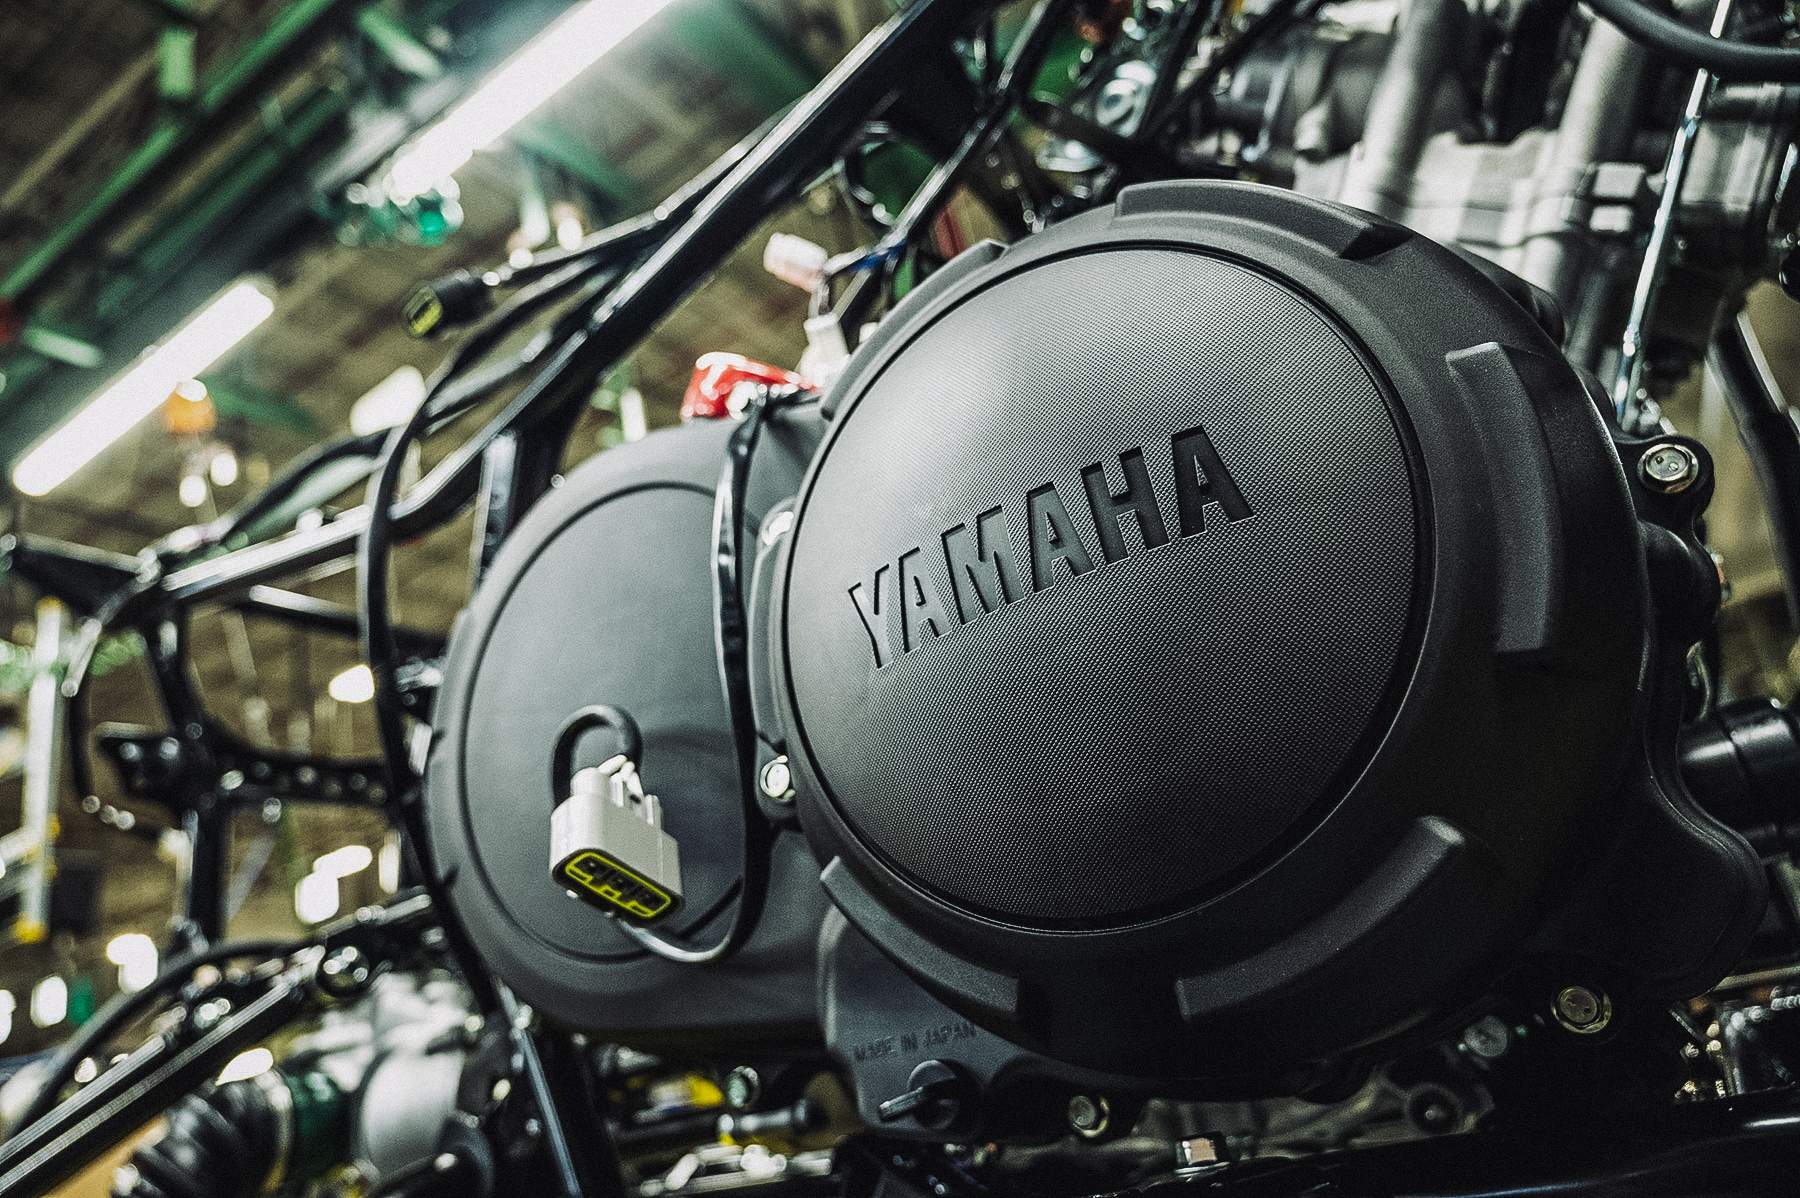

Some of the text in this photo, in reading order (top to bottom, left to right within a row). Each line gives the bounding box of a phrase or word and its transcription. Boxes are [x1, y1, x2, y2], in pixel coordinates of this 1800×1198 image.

[848, 425, 1254, 669] YAMAHA
[852, 1021, 977, 1061] MADE IN JAPAN
